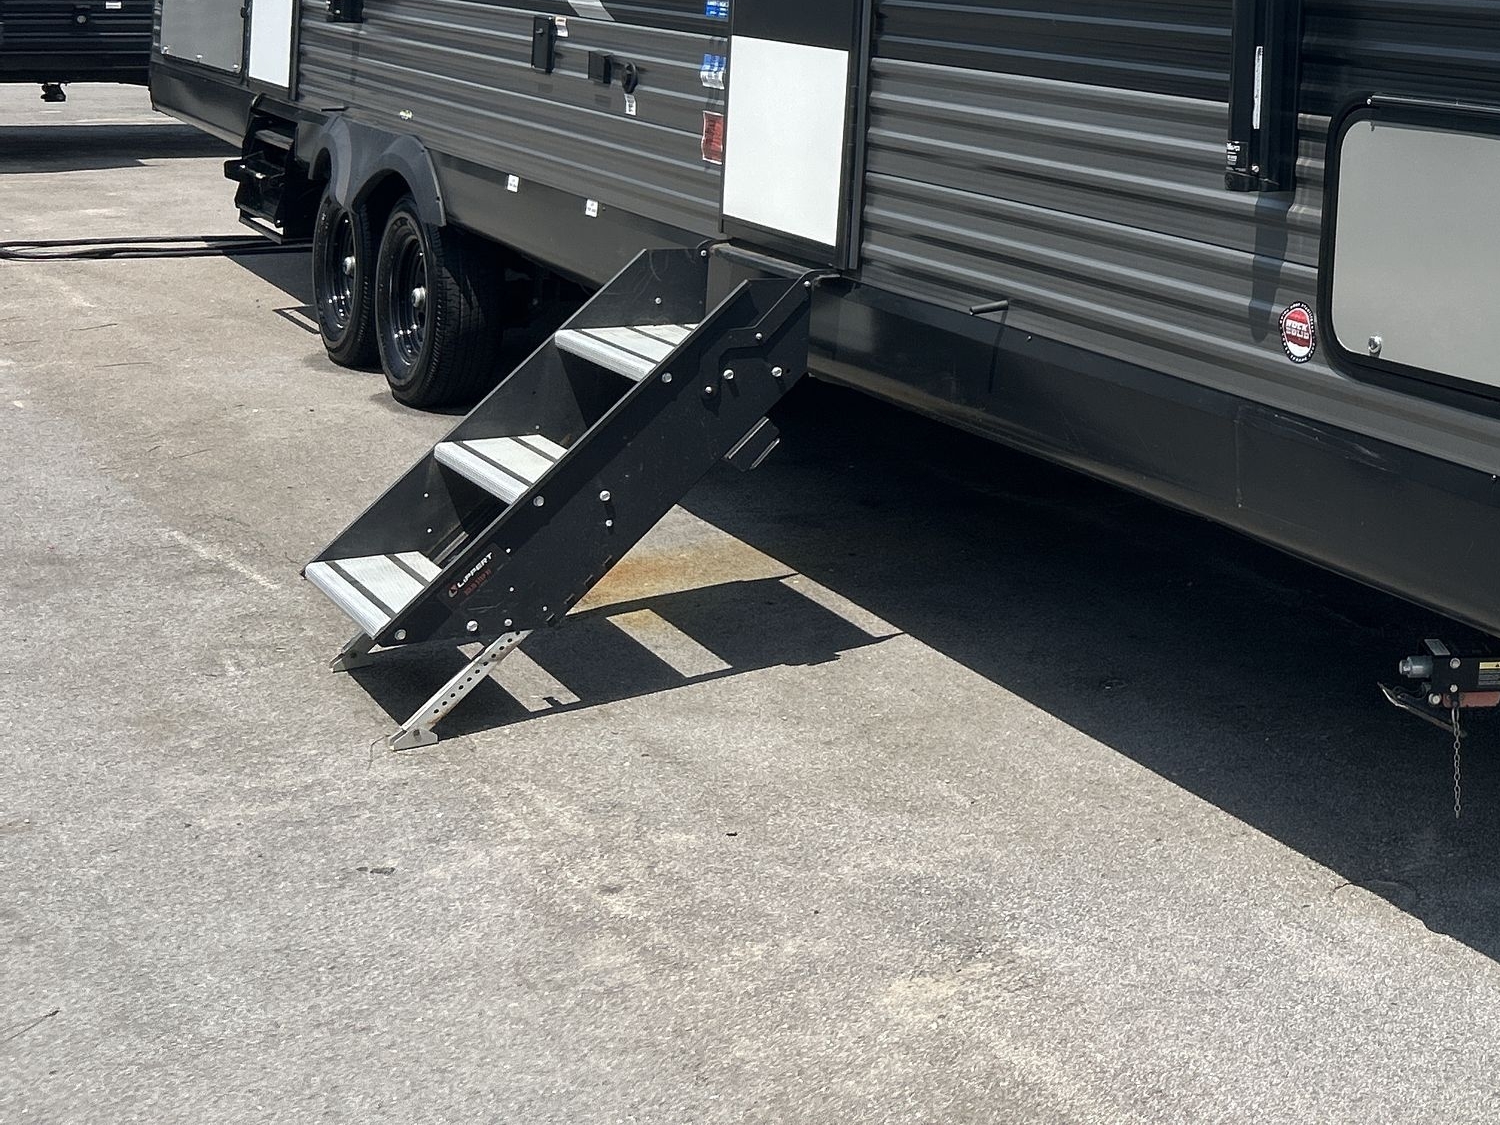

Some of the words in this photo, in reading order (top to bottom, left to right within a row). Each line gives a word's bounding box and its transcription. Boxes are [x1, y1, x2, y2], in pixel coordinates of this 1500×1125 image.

[1286, 319, 1308, 331] ROCK
[1286, 327, 1310, 340] SOLID
[457, 552, 492, 587] LIPPERT
